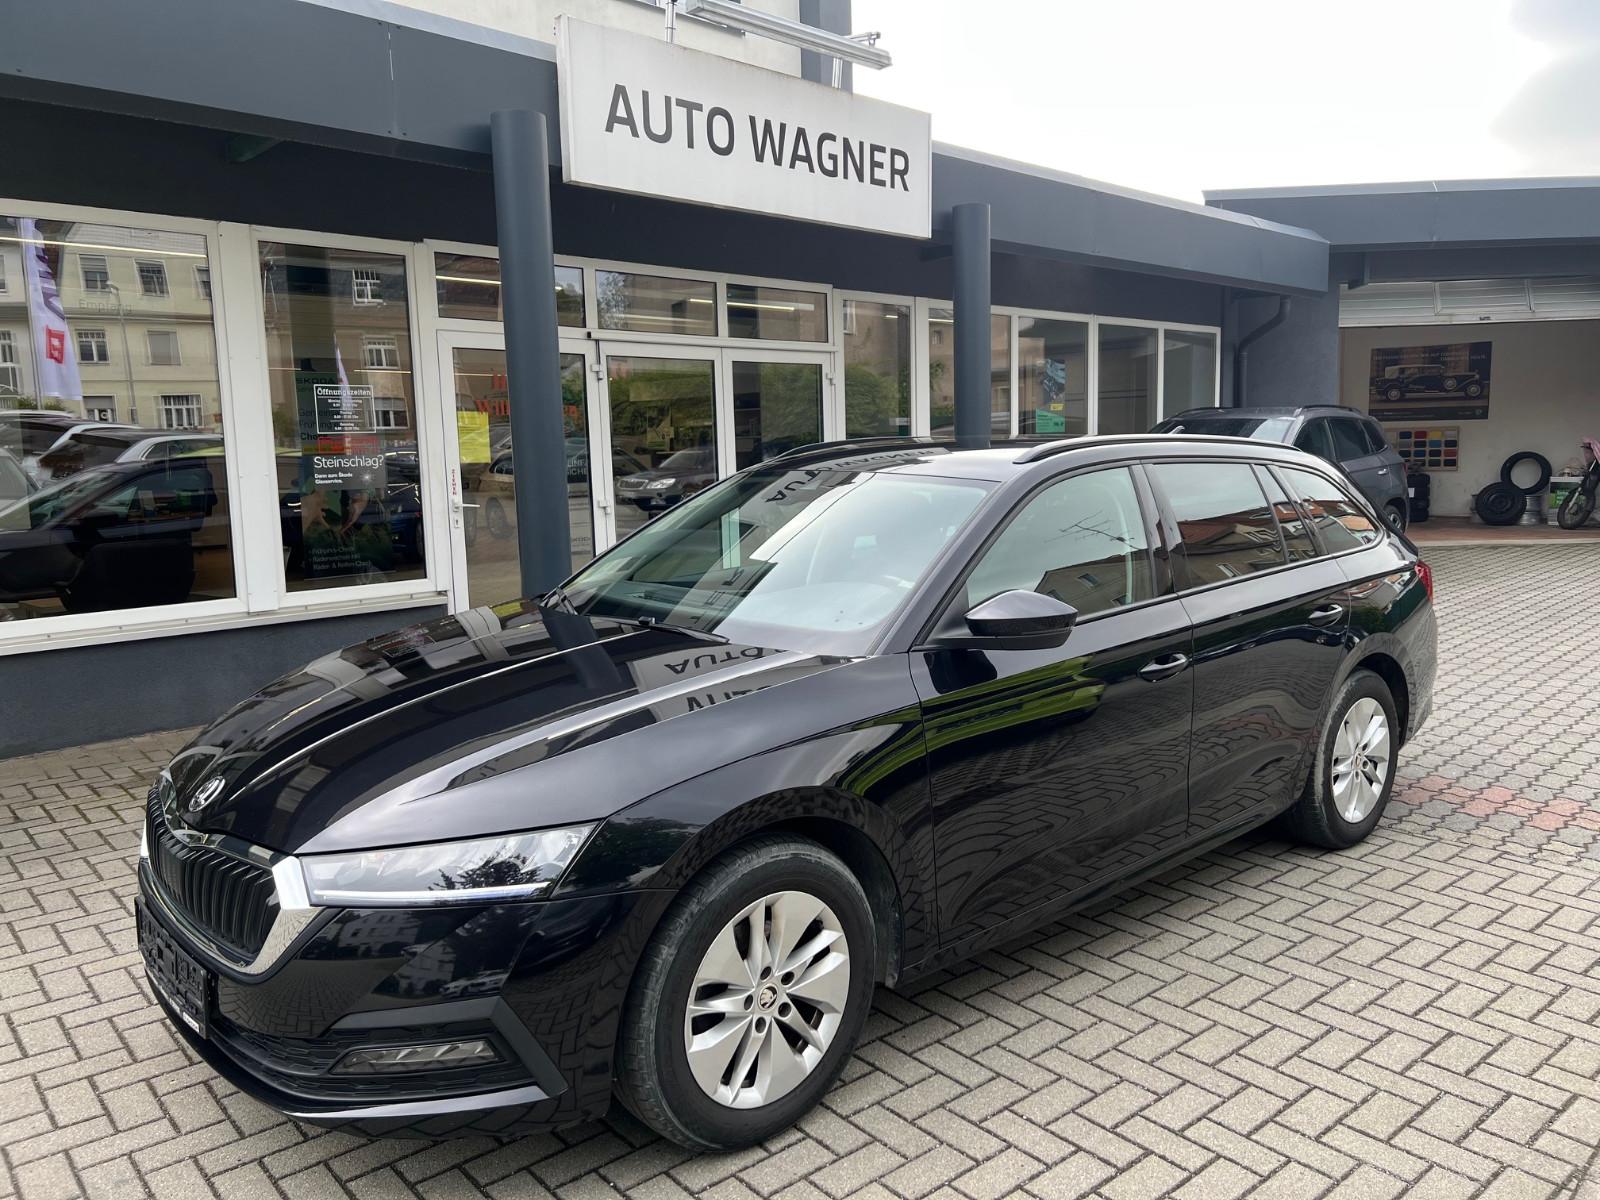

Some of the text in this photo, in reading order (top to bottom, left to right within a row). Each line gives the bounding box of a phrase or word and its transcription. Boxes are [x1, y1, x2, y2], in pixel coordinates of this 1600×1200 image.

[604, 83, 910, 192] AUTO WAGNER
[317, 387, 371, 396] Öffnungszeiten
[313, 454, 384, 469] Steinschlag?
